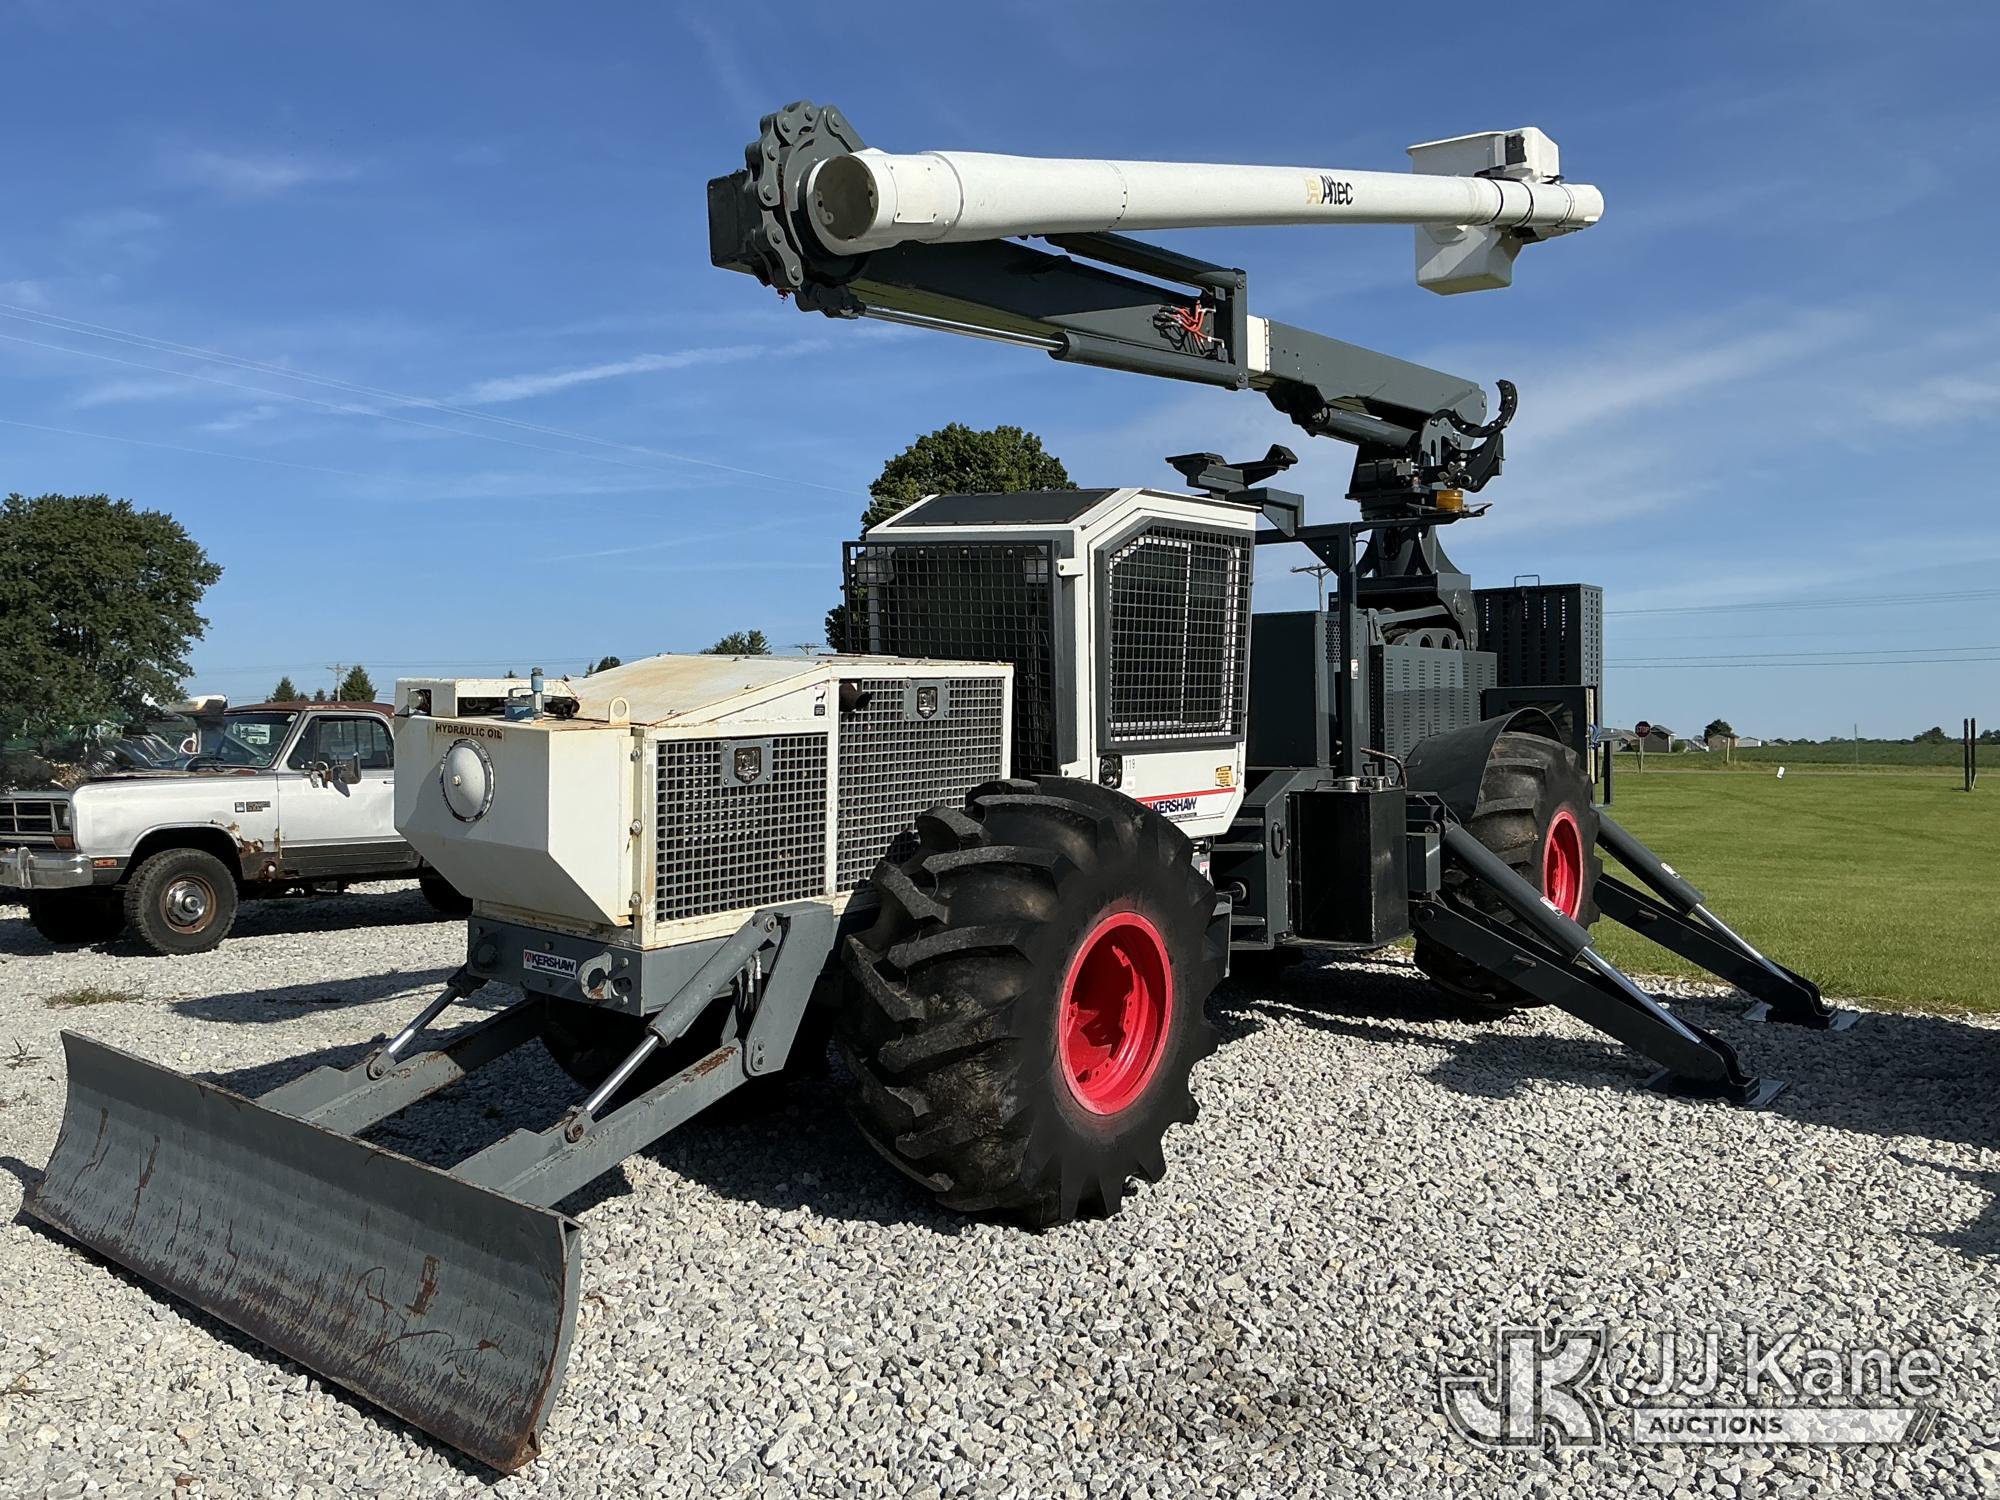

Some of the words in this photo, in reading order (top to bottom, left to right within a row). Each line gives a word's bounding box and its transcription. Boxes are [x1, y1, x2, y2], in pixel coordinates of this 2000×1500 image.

[1320, 175, 1353, 205] Altec
[435, 722, 485, 737] HYDRAULIC
[1636, 725, 1650, 733] STOP
[1152, 797, 1197, 813] KERSHAW
[531, 952, 576, 972] KERSHAW
